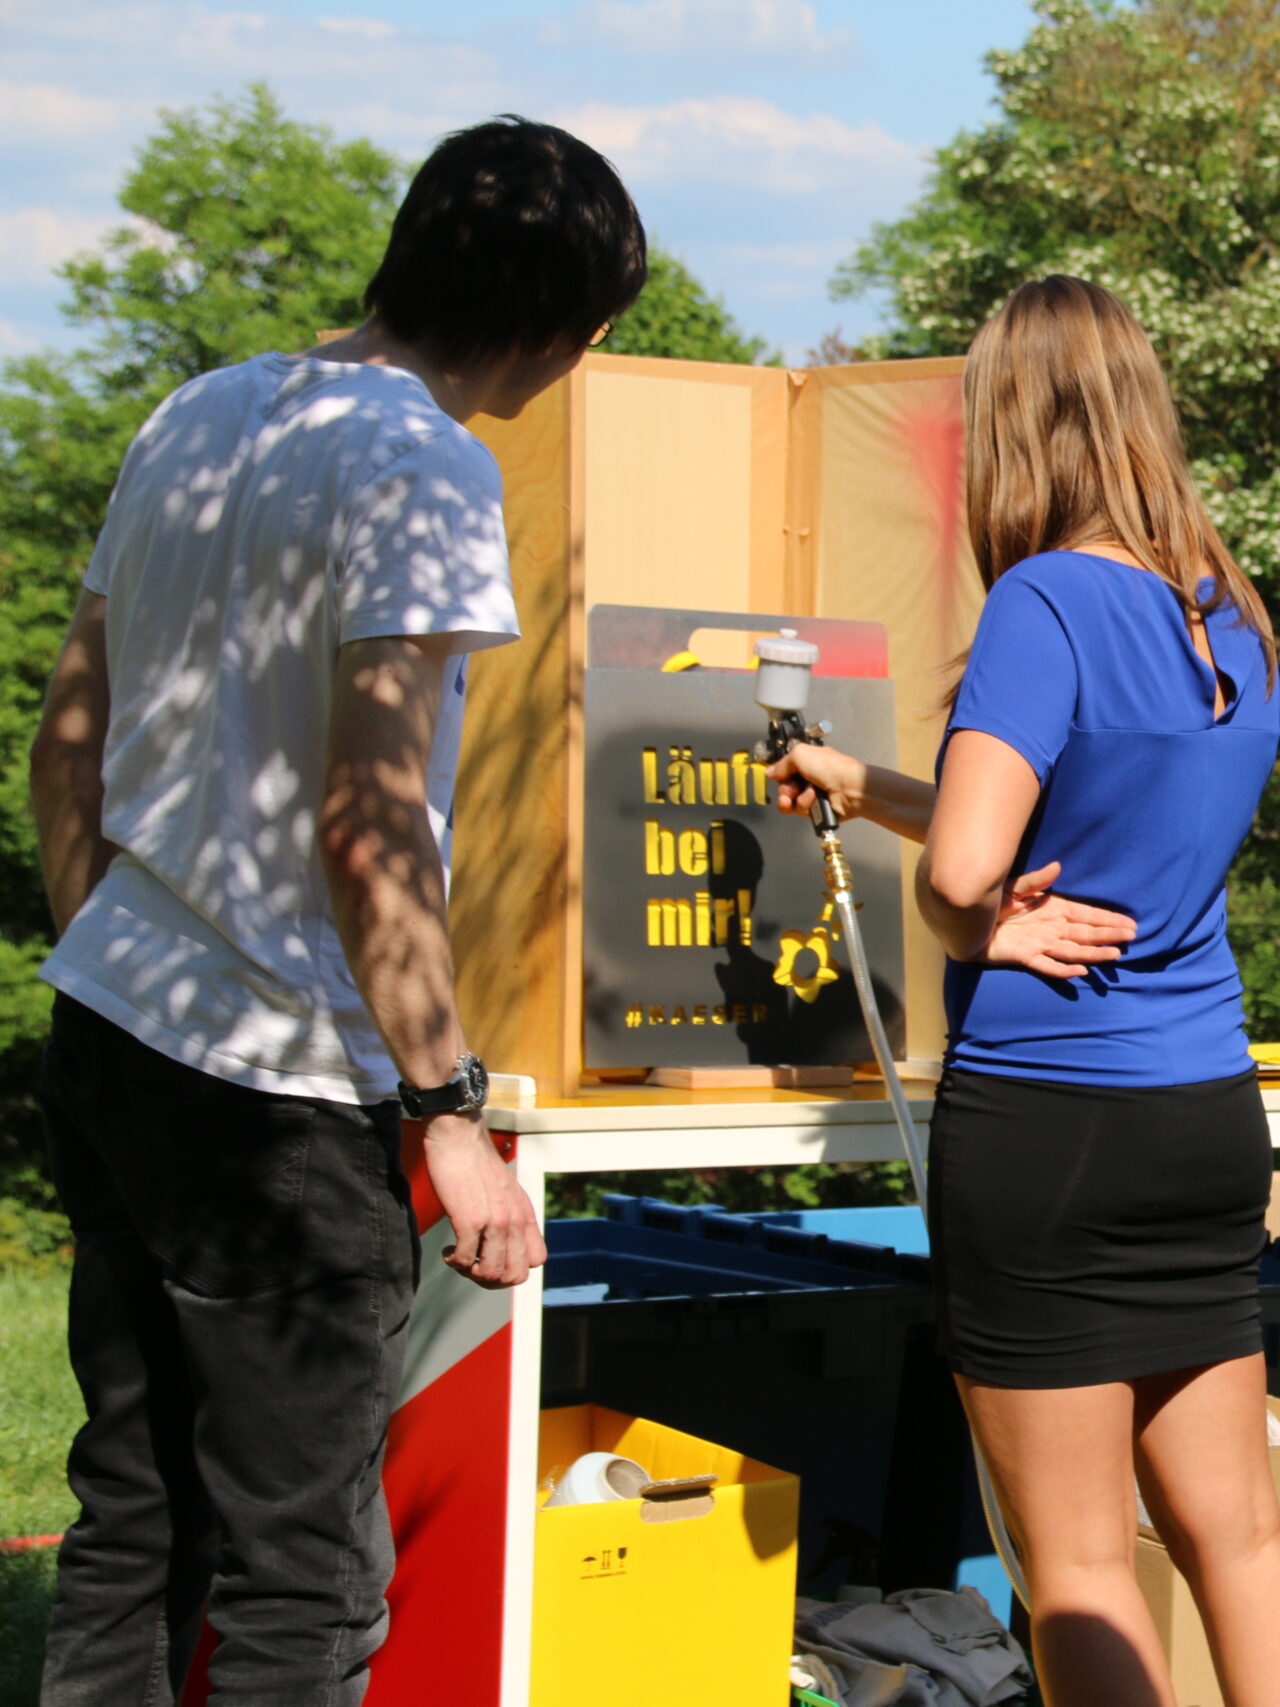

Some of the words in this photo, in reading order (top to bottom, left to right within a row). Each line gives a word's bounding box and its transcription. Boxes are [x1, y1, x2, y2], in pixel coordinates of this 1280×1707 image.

[642, 746, 771, 805] Läuft
[645, 818, 726, 876] bei
[647, 889, 752, 946] mir!
[625, 1003, 768, 1028] #KAESER
